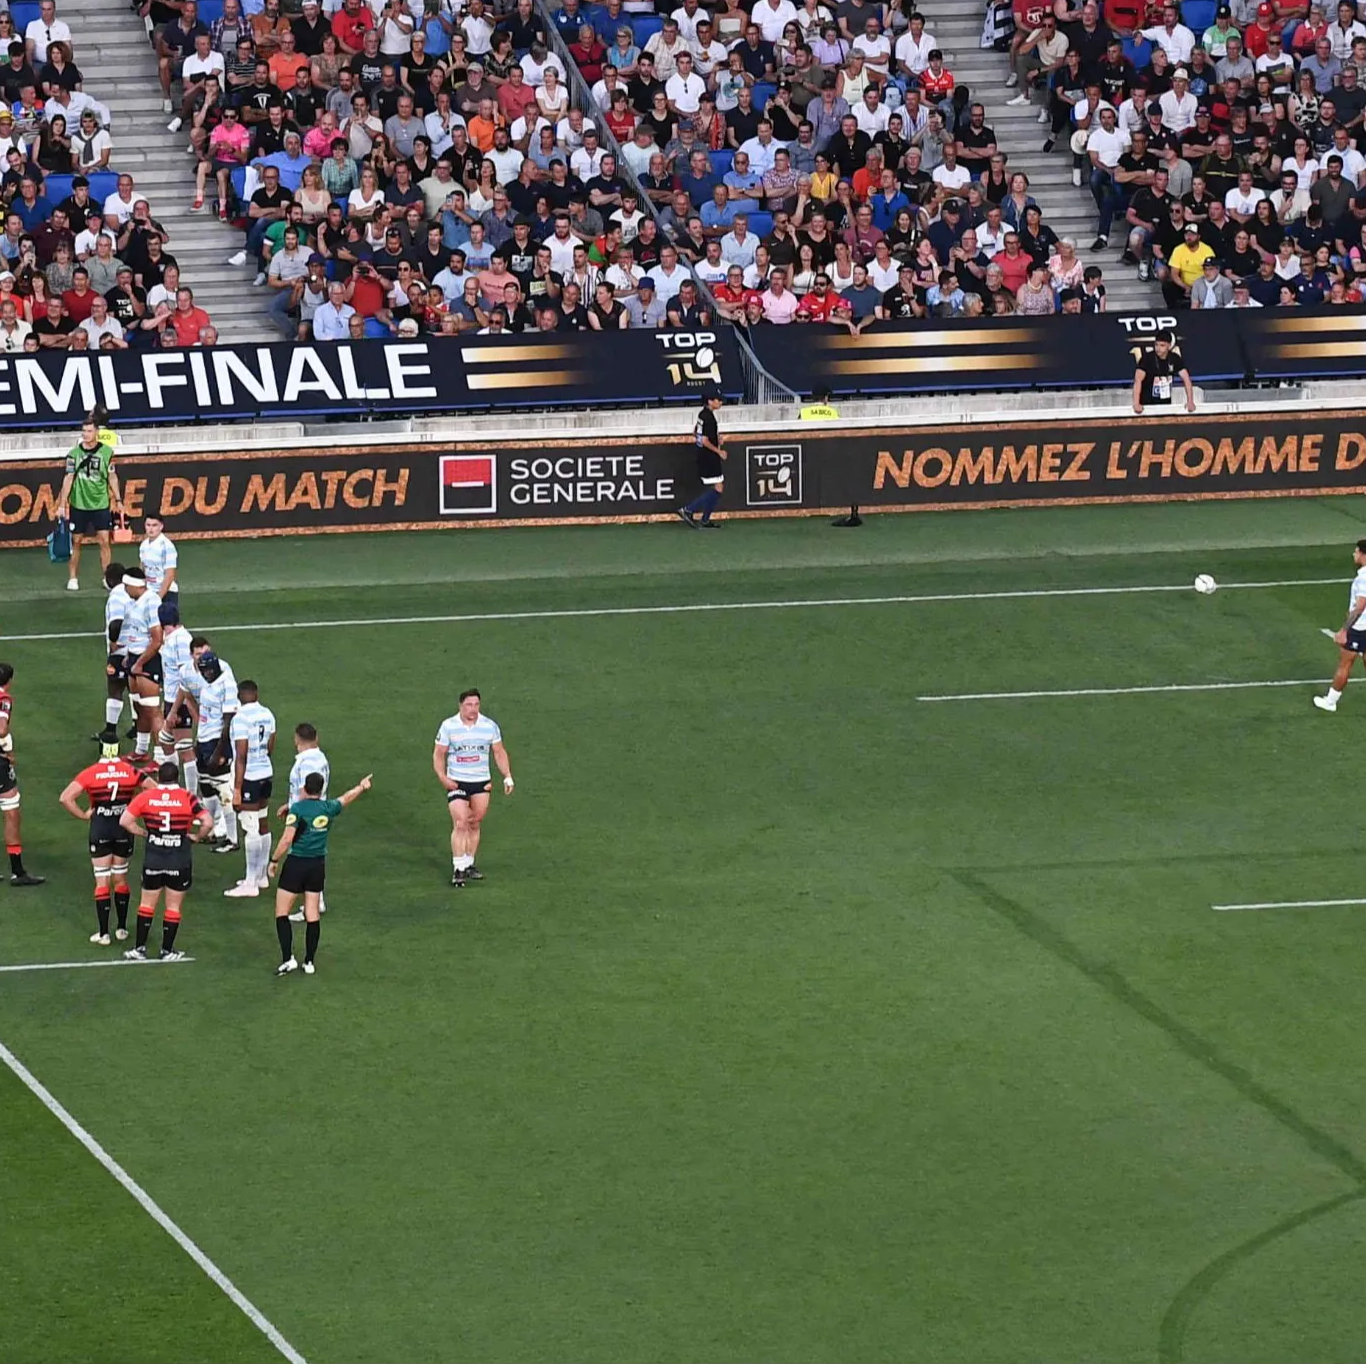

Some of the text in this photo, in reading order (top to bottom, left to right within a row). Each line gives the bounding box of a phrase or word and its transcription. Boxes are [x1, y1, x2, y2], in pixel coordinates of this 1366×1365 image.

[1118, 316, 1177, 332] TOP
[655, 332, 716, 348] TOP
[666, 362, 723, 385] 14
[510, 455, 644, 480] SOCIETE
[753, 454, 794, 466] TOP
[873, 442, 1096, 489] NOMMEZ
[1106, 434, 1324, 480] L'HOMME
[159, 475, 231, 516] DU
[240, 468, 410, 513] MATCH
[510, 479, 675, 505] GENERALE
[757, 478, 792, 497] 14
[107, 781, 118, 802] 7
[158, 811, 170, 833] 3
